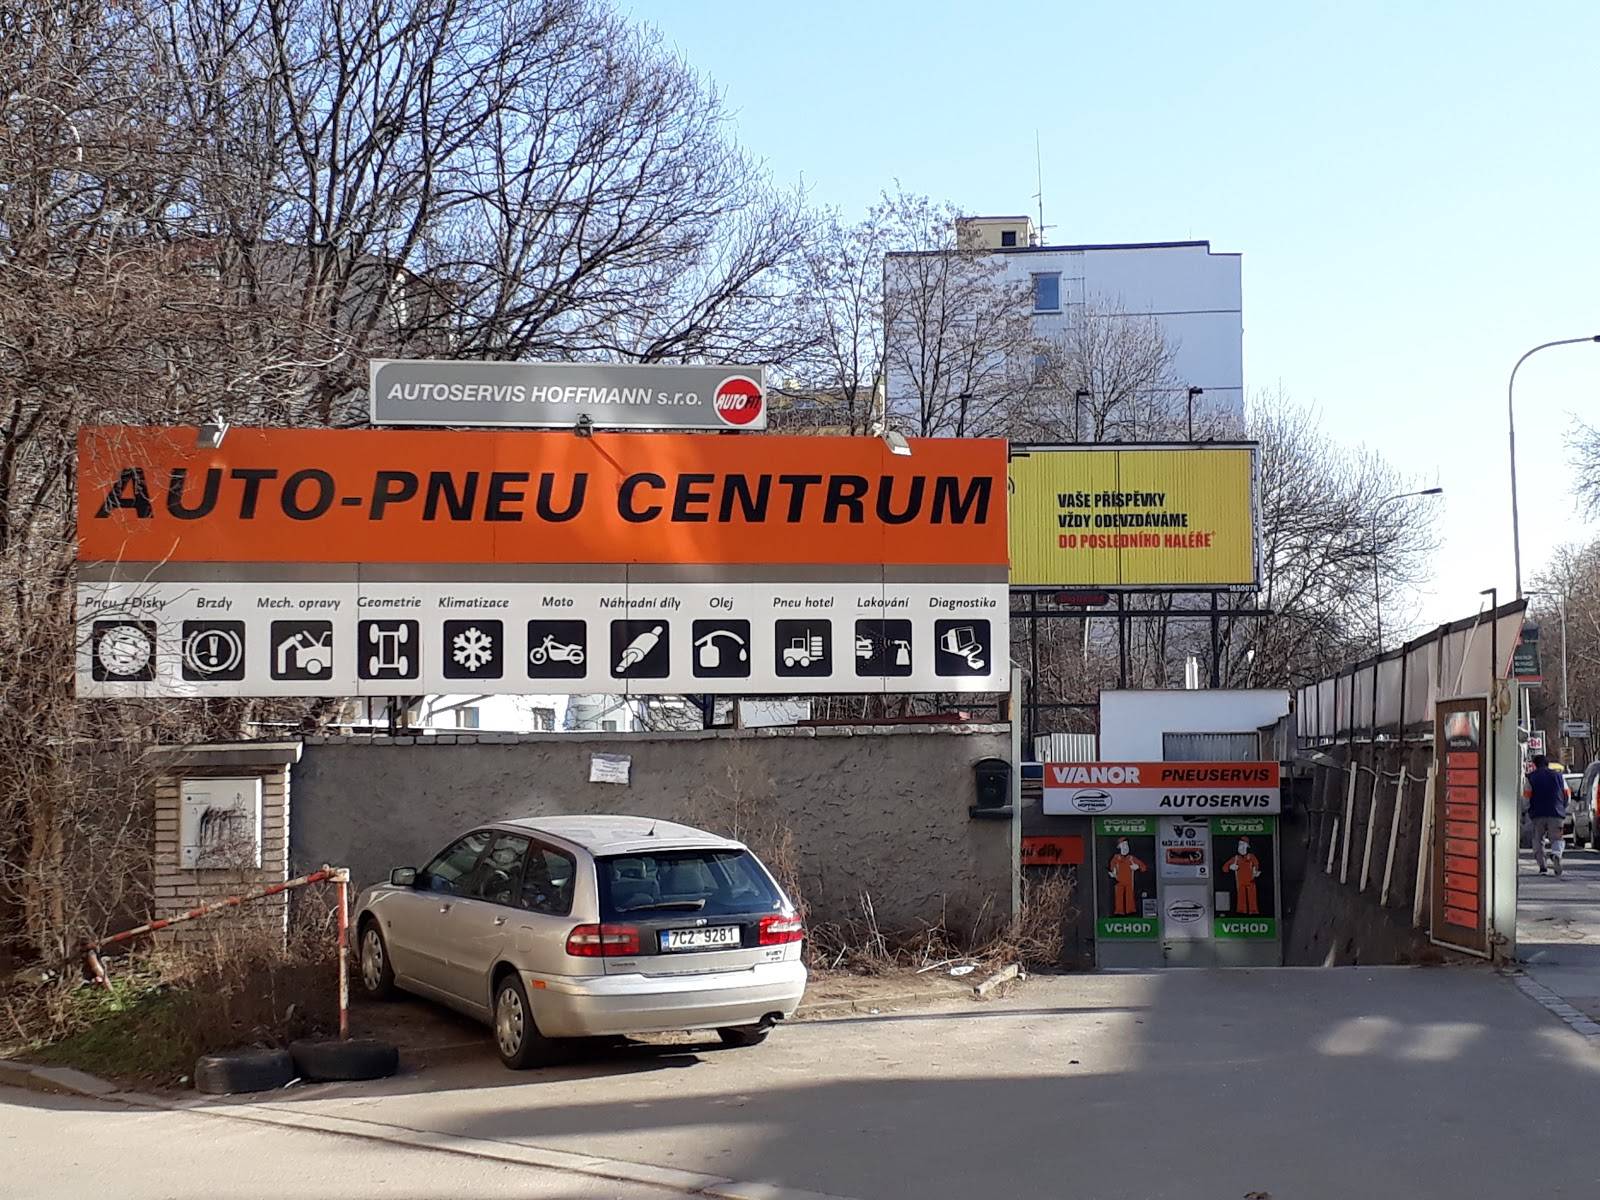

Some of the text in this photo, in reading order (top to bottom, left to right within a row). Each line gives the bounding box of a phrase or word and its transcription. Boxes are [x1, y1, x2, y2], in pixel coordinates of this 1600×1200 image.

[387, 383, 703, 407] AUTOSERVIS HOFFMANN s.r.o.
[93, 466, 993, 525] AUTO-PNEU CENTRUM
[1057, 489, 1166, 508] VAŠE PŘÍSPĚVKY
[1057, 510, 1189, 528] VŽDY ODEVZDÁVÁME
[1058, 534, 1077, 549] DO
[1080, 530, 1161, 549] POSLEDNÍHO
[84, 597, 118, 609] Pneu
[196, 597, 233, 612] Brzdy
[256, 597, 341, 612] Mech. opravy
[356, 596, 422, 608] Geometrie
[438, 597, 510, 609] Klimatizace
[541, 596, 575, 608] Moto
[599, 597, 681, 611] Náhradní díly
[708, 597, 735, 611] Olej
[772, 596, 835, 608] Pneu hotel
[856, 597, 910, 609] Lakování
[928, 597, 997, 610] Diagnostika
[1160, 768, 1271, 783] PNEUSERVIS
[1159, 794, 1271, 808] AUTOSERVIS
[1104, 923, 1152, 934] VCHOD
[1221, 923, 1269, 934] VCHOD
[672, 927, 734, 946] 7C2 9281
